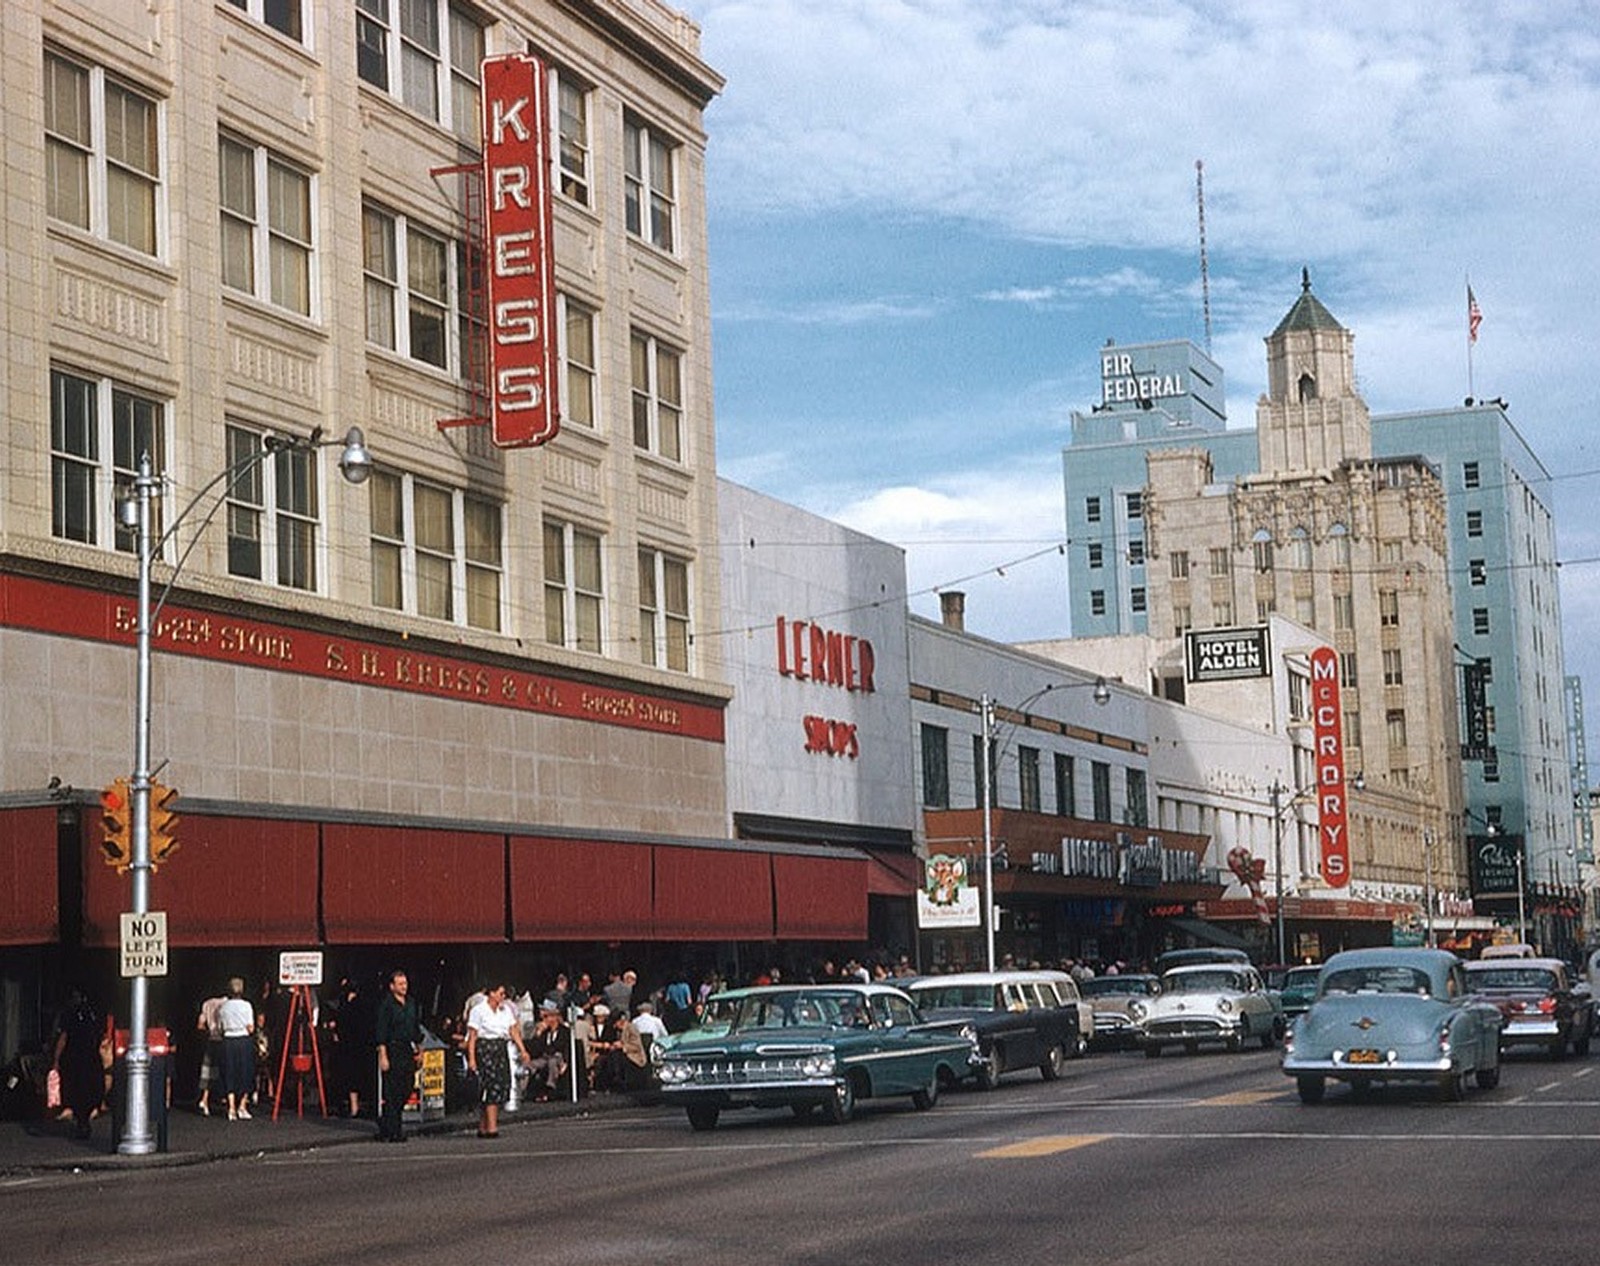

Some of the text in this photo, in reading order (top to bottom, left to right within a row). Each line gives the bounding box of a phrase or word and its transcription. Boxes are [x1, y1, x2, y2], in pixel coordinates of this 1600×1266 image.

[492, 97, 543, 412] KRESS
[1103, 353, 1133, 378] FIR
[1103, 374, 1185, 402] FEDERAL
[775, 614, 876, 694] LERNER
[1199, 640, 1259, 657] HOTEL
[220, 626, 293, 660] STORE
[326, 642, 349, 672] S.
[396, 655, 491, 697] KRESS
[501, 673, 517, 701] &
[1199, 653, 1260, 671] ALDEN
[131, 919, 157, 938] NO
[125, 940, 163, 953] LEFT
[125, 955, 164, 968] TURN
